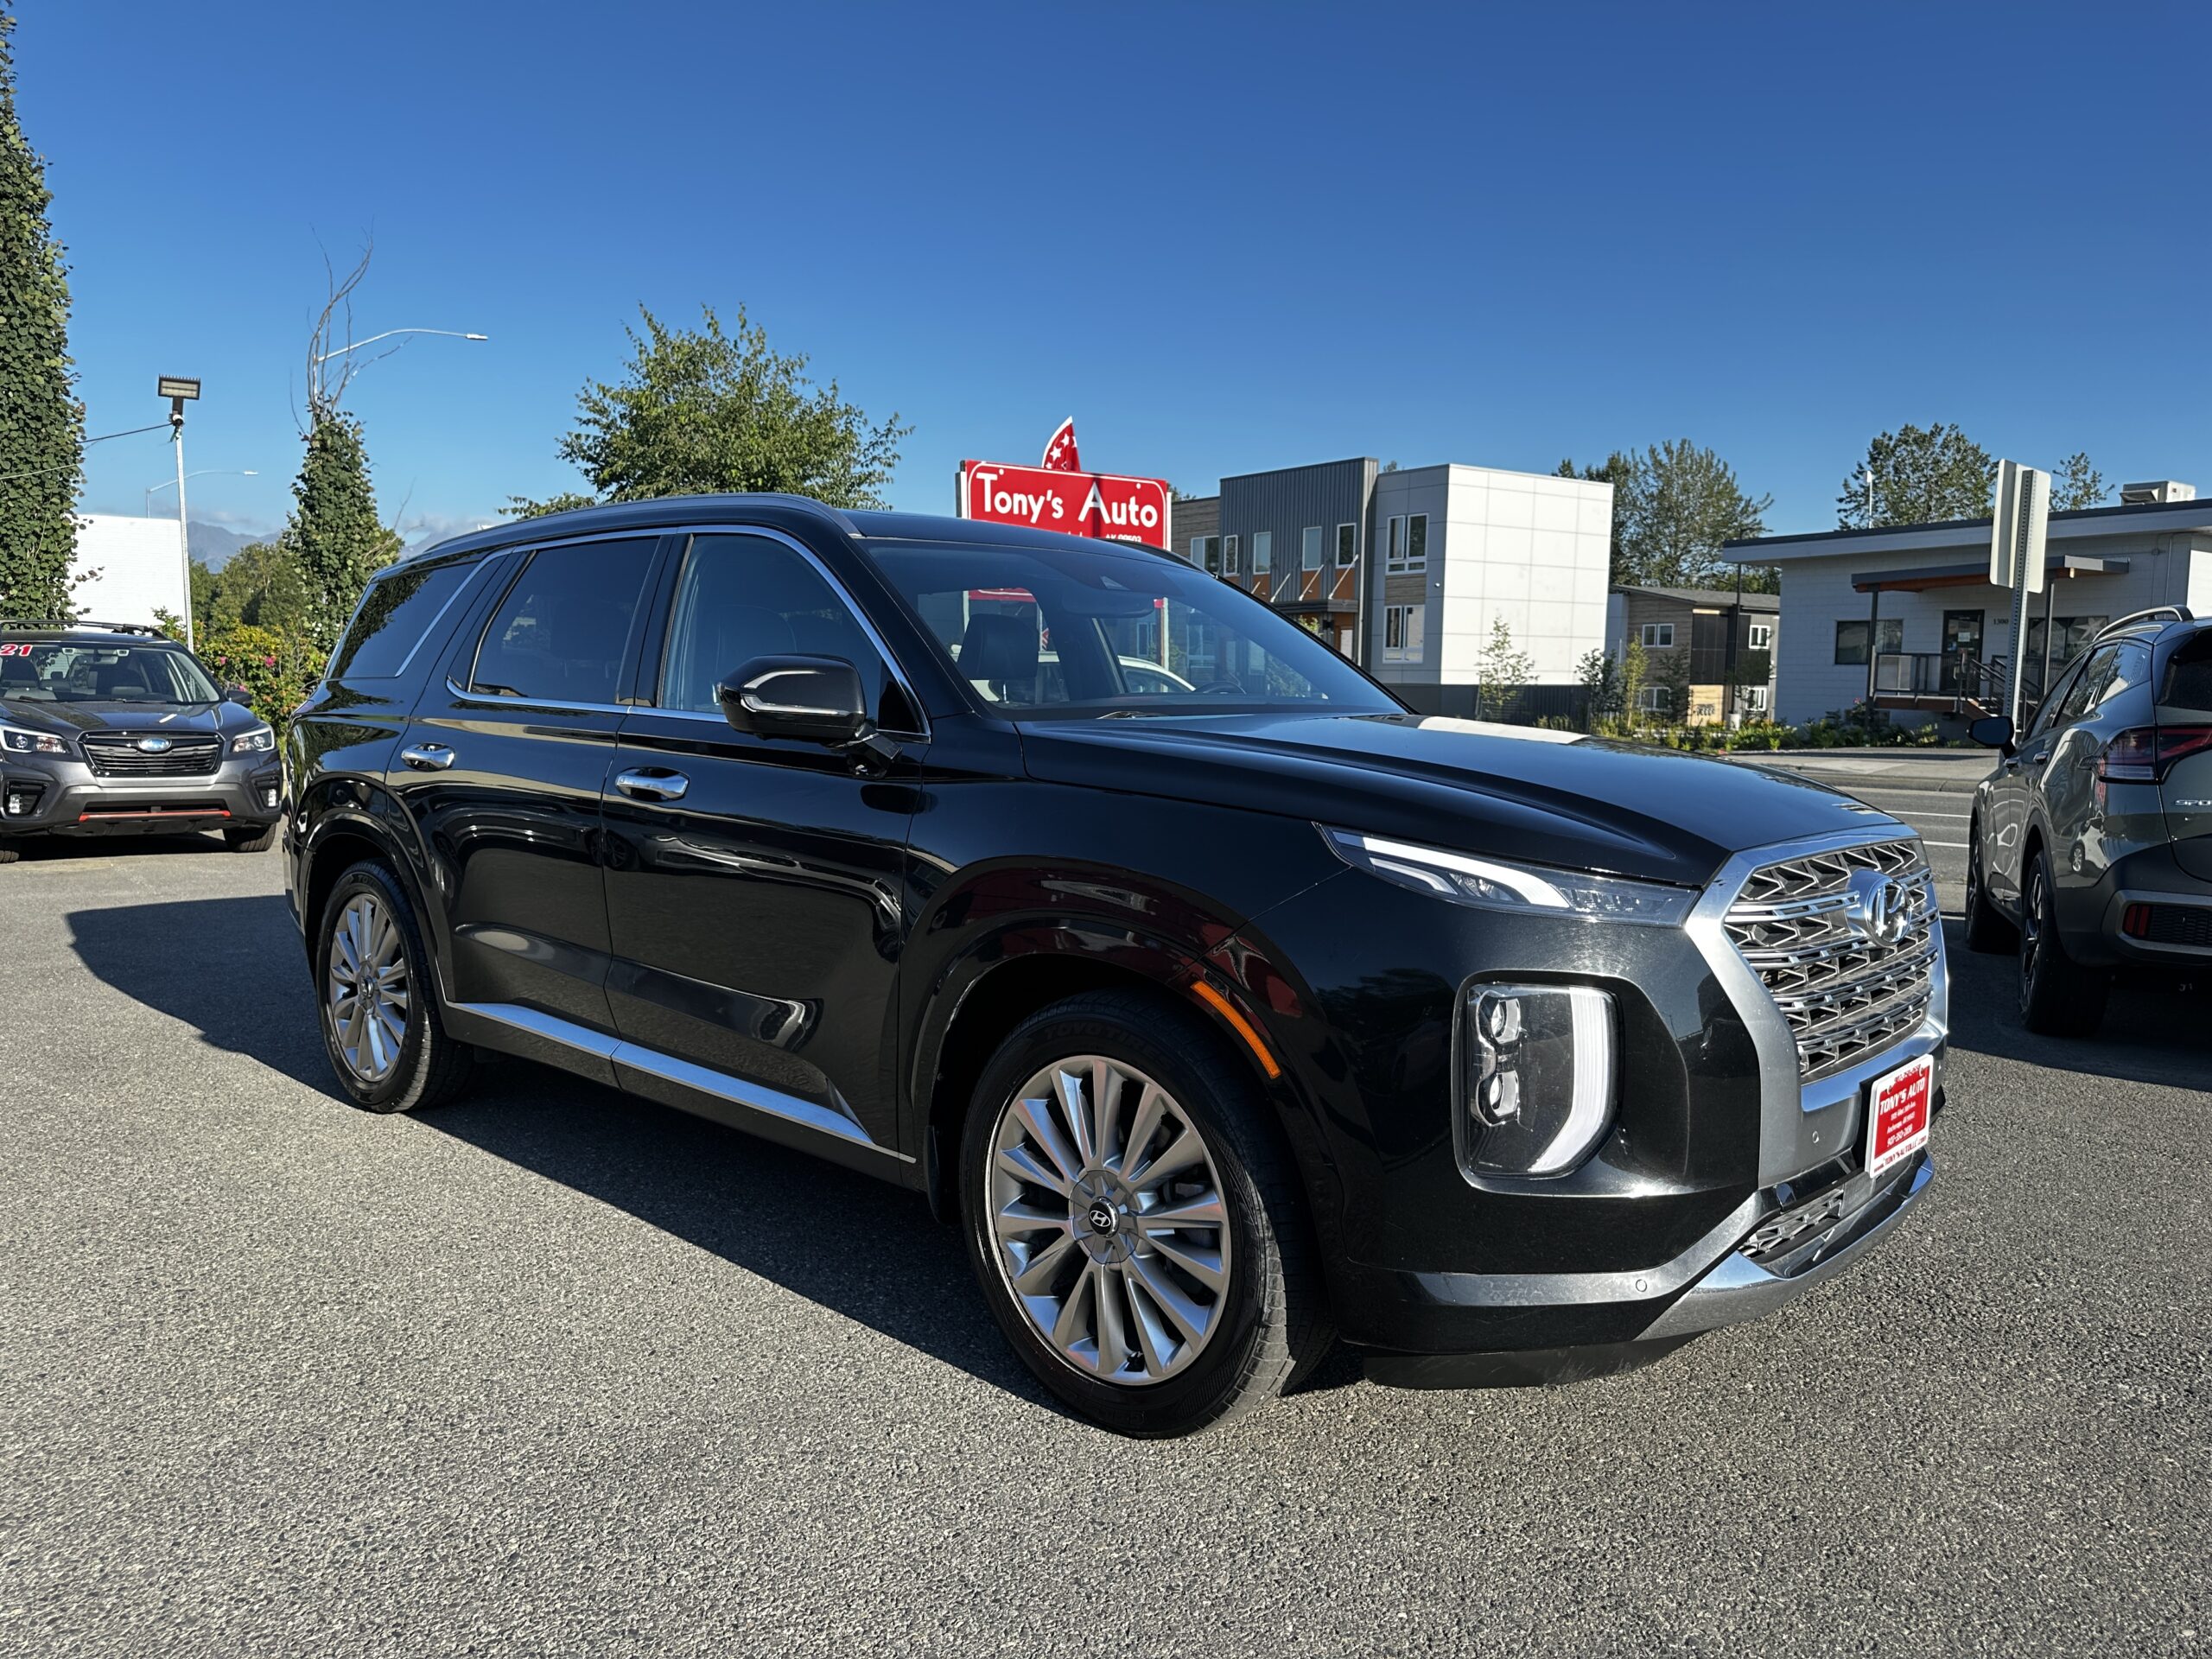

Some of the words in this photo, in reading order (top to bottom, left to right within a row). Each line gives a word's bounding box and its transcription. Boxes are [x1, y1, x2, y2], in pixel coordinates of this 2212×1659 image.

[976, 472, 1064, 524] Tony's
[1077, 481, 1159, 528] Auto
[0, 644, 34, 657] 21
[1880, 1088, 1907, 1116] TONY'S
[1907, 1077, 1926, 1101] AUTO
